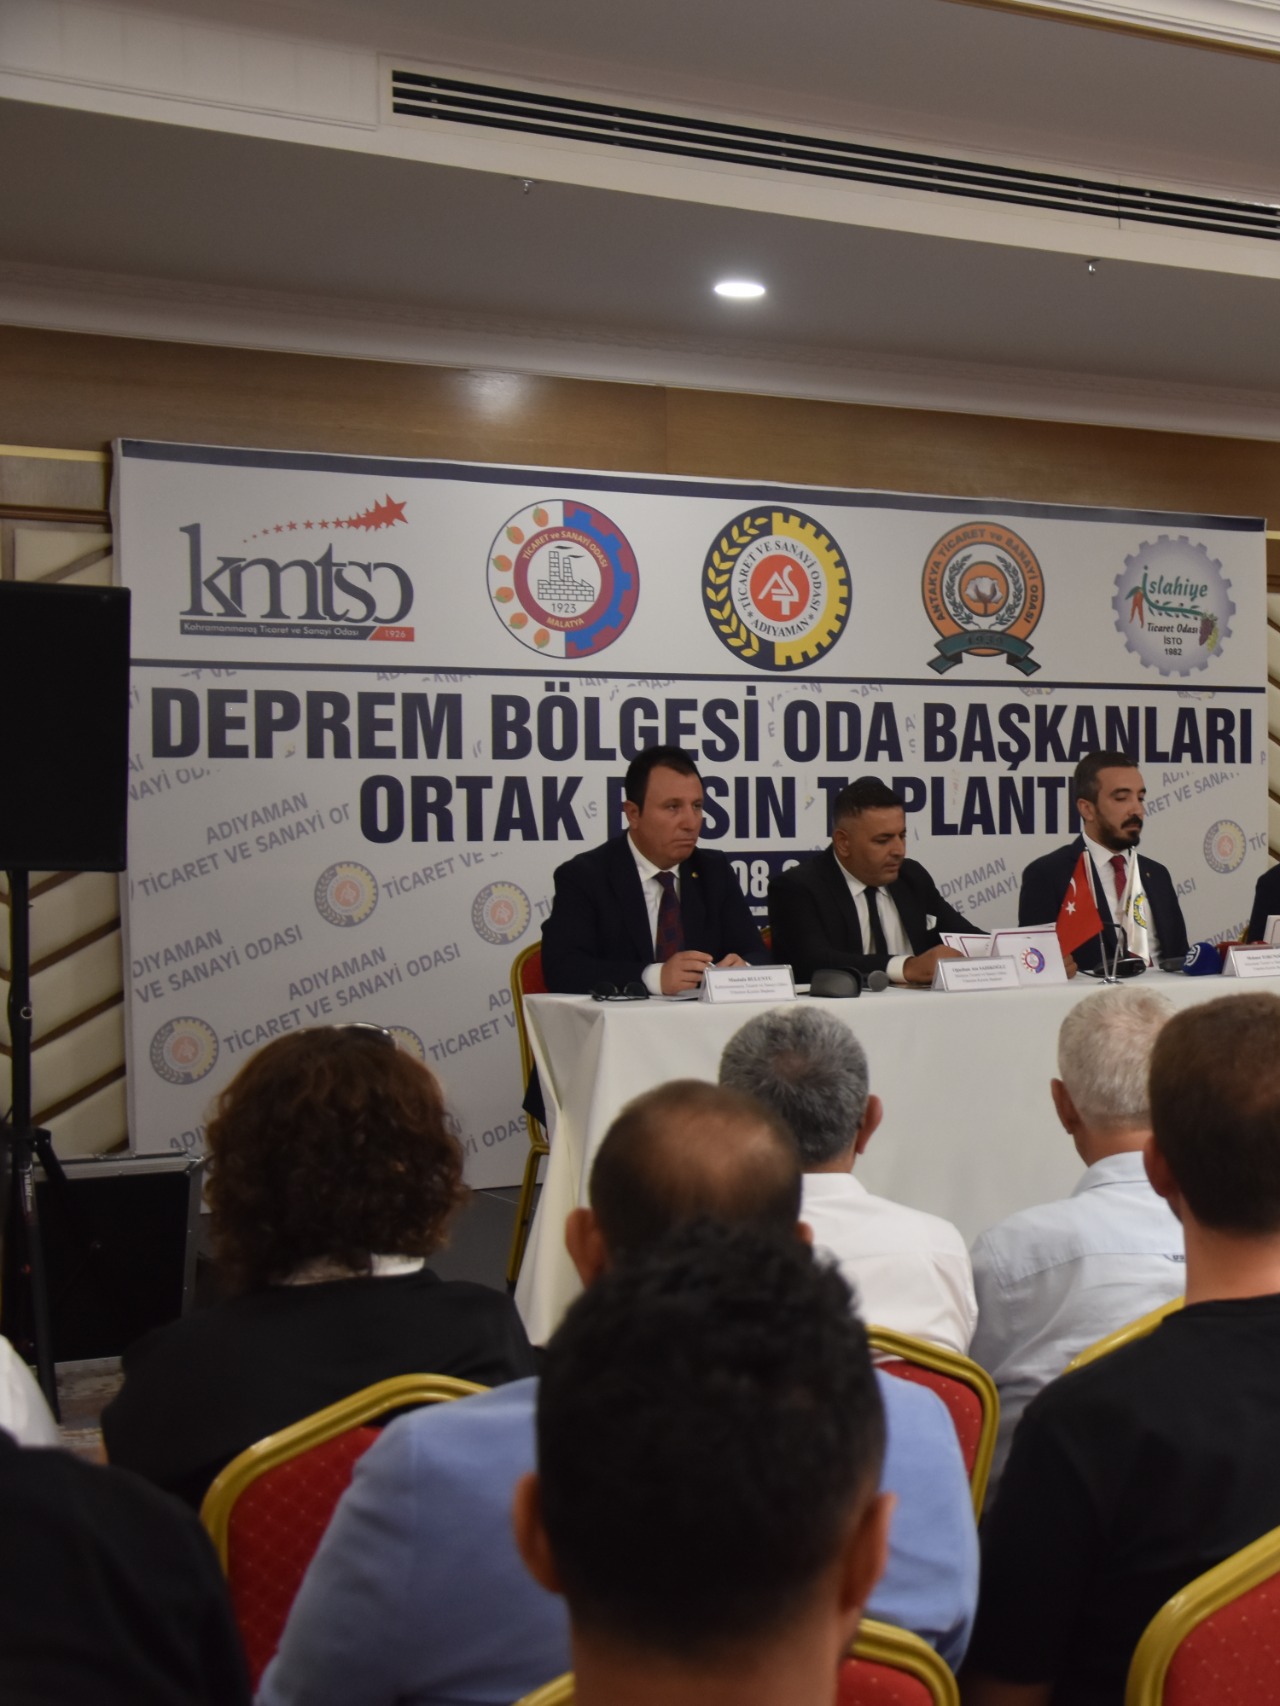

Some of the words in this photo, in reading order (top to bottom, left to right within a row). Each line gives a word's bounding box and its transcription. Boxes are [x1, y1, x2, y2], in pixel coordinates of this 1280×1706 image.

[522, 533, 549, 560] TİCARET
[561, 531, 591, 547] SANAYİ
[590, 543, 608, 568] ODASI
[738, 552, 757, 610] TİCARET
[756, 541, 773, 554] VE
[775, 541, 816, 568] SANAYİ
[810, 570, 822, 611] ODASI
[928, 561, 945, 621] ANTAKYA
[938, 529, 986, 557] TİCARET
[990, 532, 1003, 541] ve
[1005, 538, 1039, 580] SANAYİ
[1024, 583, 1038, 624] ODASI
[546, 617, 585, 628] MALATYA
[552, 603, 576, 613] 1923
[751, 618, 809, 637] ADIYAMAN
[1147, 622, 1174, 633] Ticaret
[1177, 624, 1198, 634] Odası
[184, 622, 257, 635] Kahramanmaraş
[260, 625, 289, 634] Ticaret
[303, 626, 331, 637] Sanayi
[334, 627, 359, 636] Odası
[385, 629, 406, 639] 1926
[1163, 635, 1182, 645] İSTO
[1164, 648, 1182, 656] 1982
[151, 687, 463, 759] DEPREM
[491, 681, 759, 762] BÖLGESİ
[784, 700, 903, 762] ODA
[923, 702, 1252, 770] BAŞKANLARI
[360, 774, 584, 843] ORTAK
[1174, 785, 1192, 802] VE
[206, 792, 308, 845] ADIYAMAN
[138, 853, 220, 899] TİCARET
[223, 842, 252, 865] VE
[255, 808, 325, 851] SANAYİ
[382, 857, 456, 901] TİCARET
[940, 857, 1006, 898] DIYAMAN
[968, 872, 1018, 909] SANAYİ
[1176, 878, 1196, 898] ASI
[132, 928, 223, 978] DIYAMAN
[136, 980, 164, 1003] VE
[168, 946, 240, 991] SANAYİ
[244, 924, 303, 960] ODASI
[287, 946, 387, 1000] ADIYAMAN
[223, 1008, 303, 1054] TİCARET
[305, 991, 333, 1015] VE
[336, 963, 403, 1008] SANAYİ
[406, 942, 461, 977] ODASI
[429, 1019, 503, 1062] TİCARET
